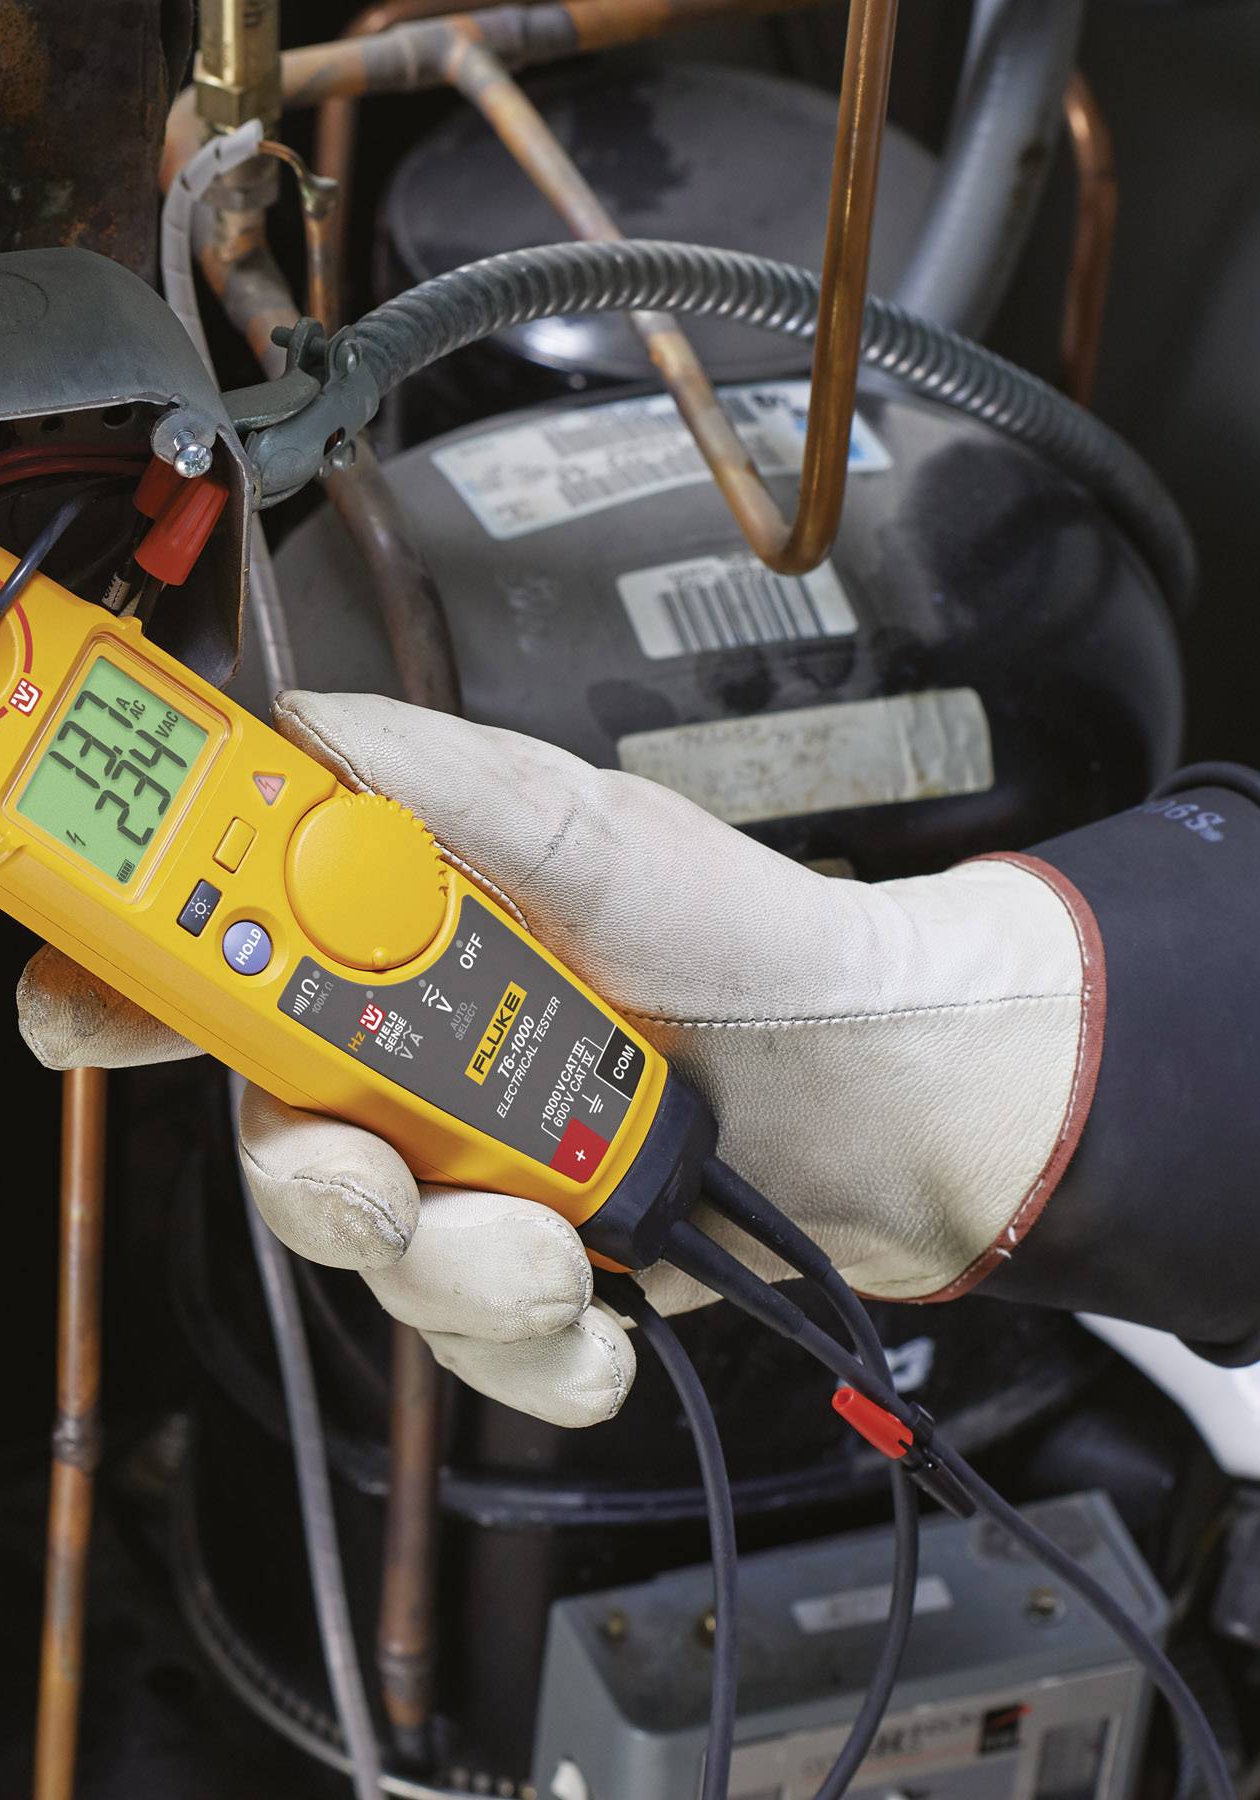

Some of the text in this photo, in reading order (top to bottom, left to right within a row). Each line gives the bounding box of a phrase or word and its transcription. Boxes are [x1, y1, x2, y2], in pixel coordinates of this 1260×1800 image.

[128, 700, 146, 721] AC
[49, 690, 133, 789] 13.7 A
[94, 711, 188, 846] 234 VAC
[235, 928, 262, 966] HOLD
[459, 932, 483, 970] OFF
[374, 1010, 398, 1048] FIELD
[384, 1016, 408, 1053] SENSE
[450, 1001, 468, 1030] AUTO
[455, 1001, 478, 1041] SELECT
[472, 991, 521, 1075] FLUKE
[347, 1030, 366, 1052] Hz
[496, 996, 561, 1119] ELECTRICAL TESTER
[497, 1015, 535, 1079] T6-1000
[580, 1049, 596, 1069] IV
[542, 1091, 562, 1122] 1000
[561, 1058, 578, 1082] CAT
[572, 1040, 586, 1058] III
[570, 1067, 591, 1094] CAT
[612, 1044, 636, 1080] COM
[553, 1101, 571, 1128] 600
